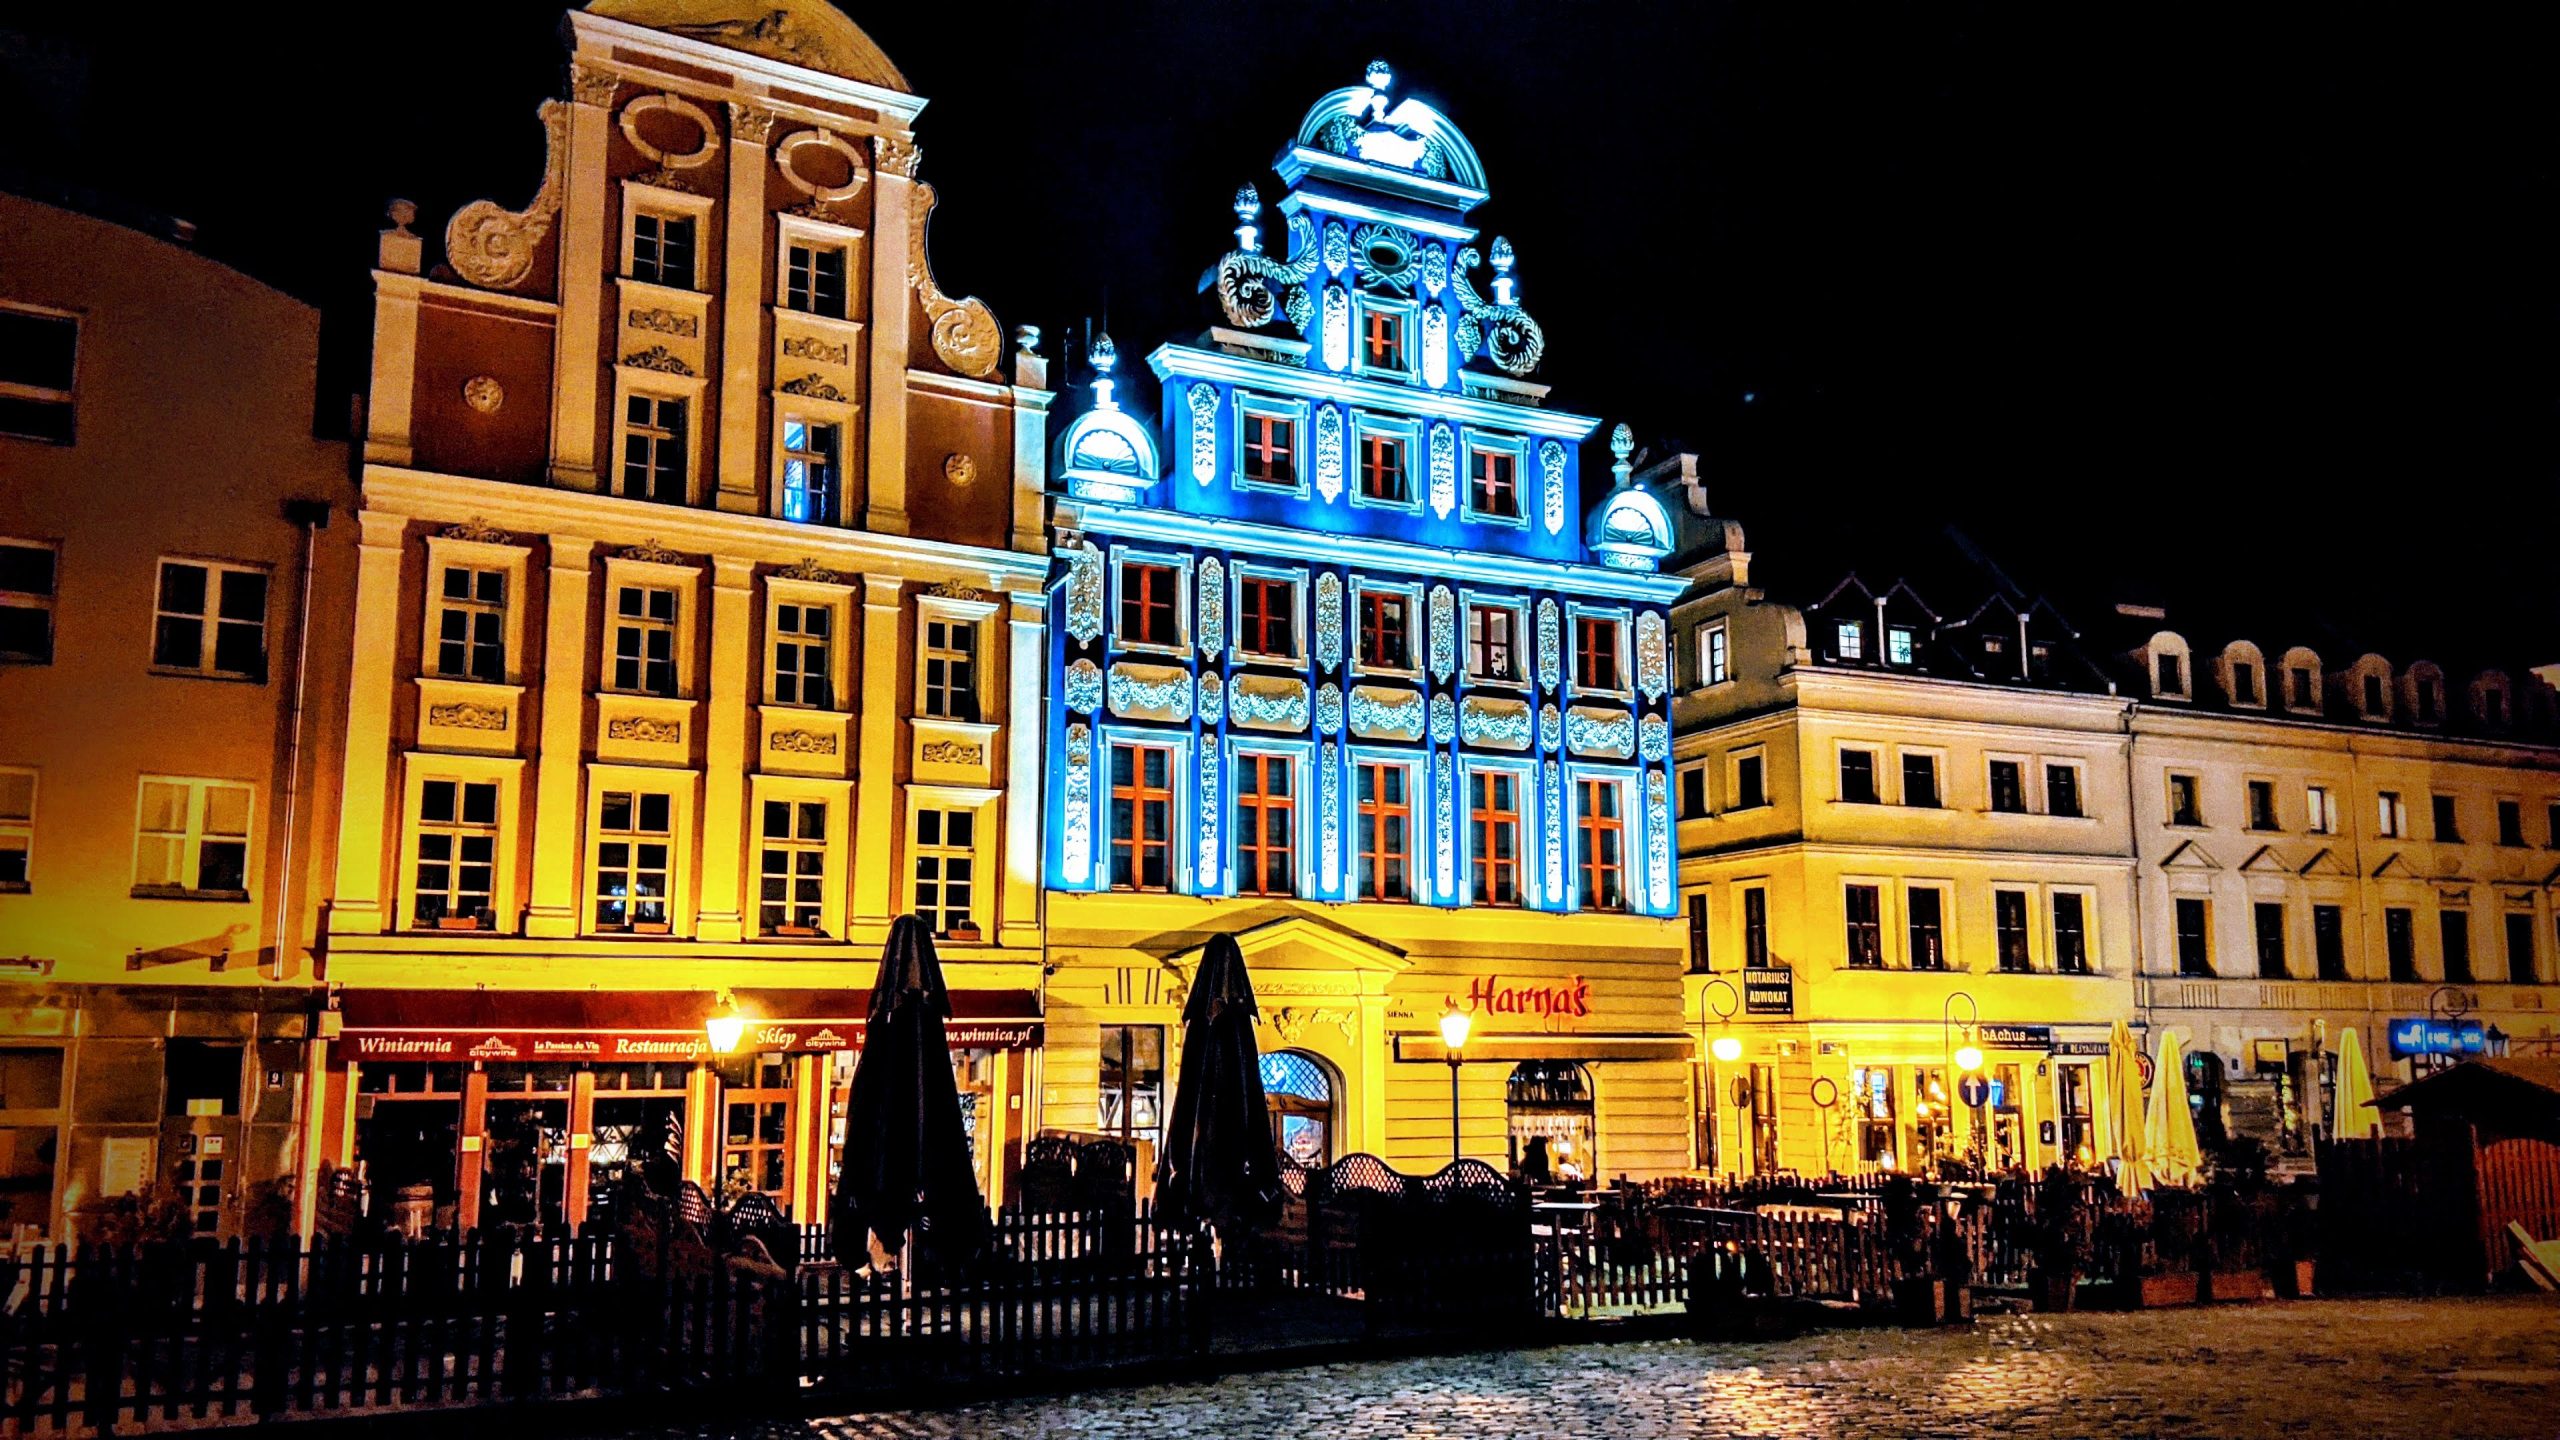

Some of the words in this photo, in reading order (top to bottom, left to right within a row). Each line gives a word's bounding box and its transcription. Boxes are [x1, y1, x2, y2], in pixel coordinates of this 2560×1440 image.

[1745, 971, 1790, 984] NOTARIUSZ
[1466, 974, 1592, 1018] Harnaś
[1749, 990, 1788, 1003] ADWOKAT
[756, 1027, 797, 1050] Sklep
[1981, 1028, 2026, 1042] bAchus
[359, 1037, 452, 1053] Winiarnia
[615, 1038, 708, 1060] Restauracja
[805, 1040, 847, 1049] citywine
[469, 1049, 518, 1058] citywine
